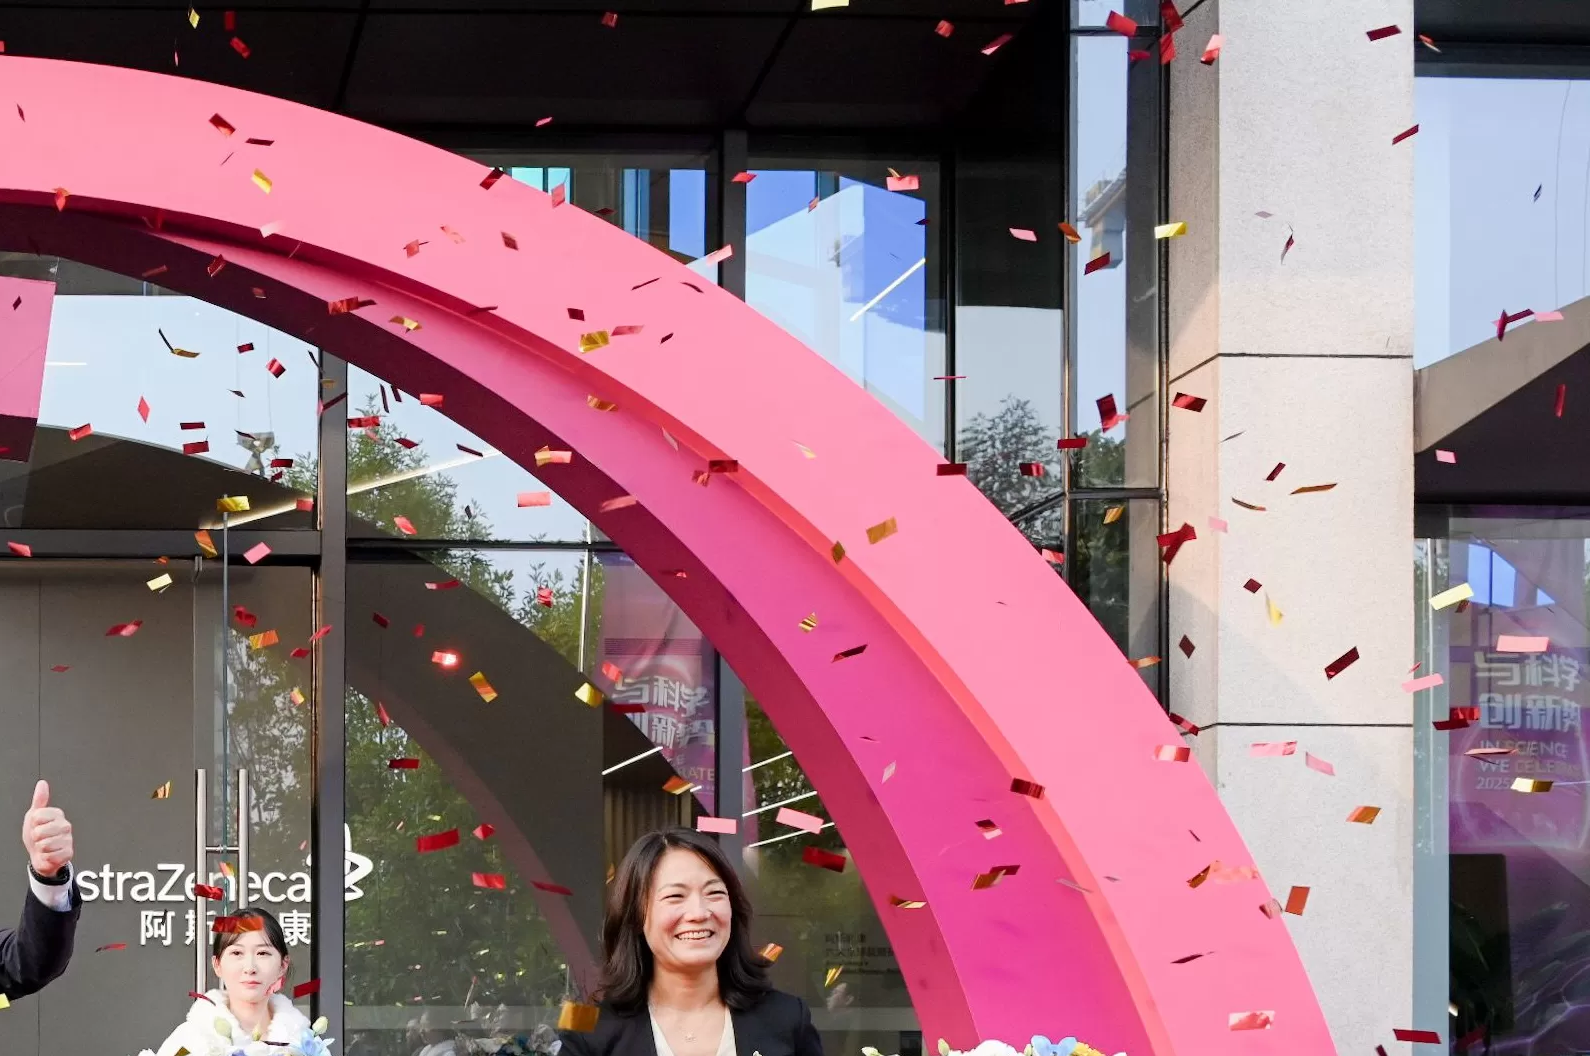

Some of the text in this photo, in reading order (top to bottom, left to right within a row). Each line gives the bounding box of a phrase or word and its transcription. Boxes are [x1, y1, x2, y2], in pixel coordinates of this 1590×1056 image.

[76, 863, 311, 903] straZeneca
[141, 909, 311, 946] 阿斯康
